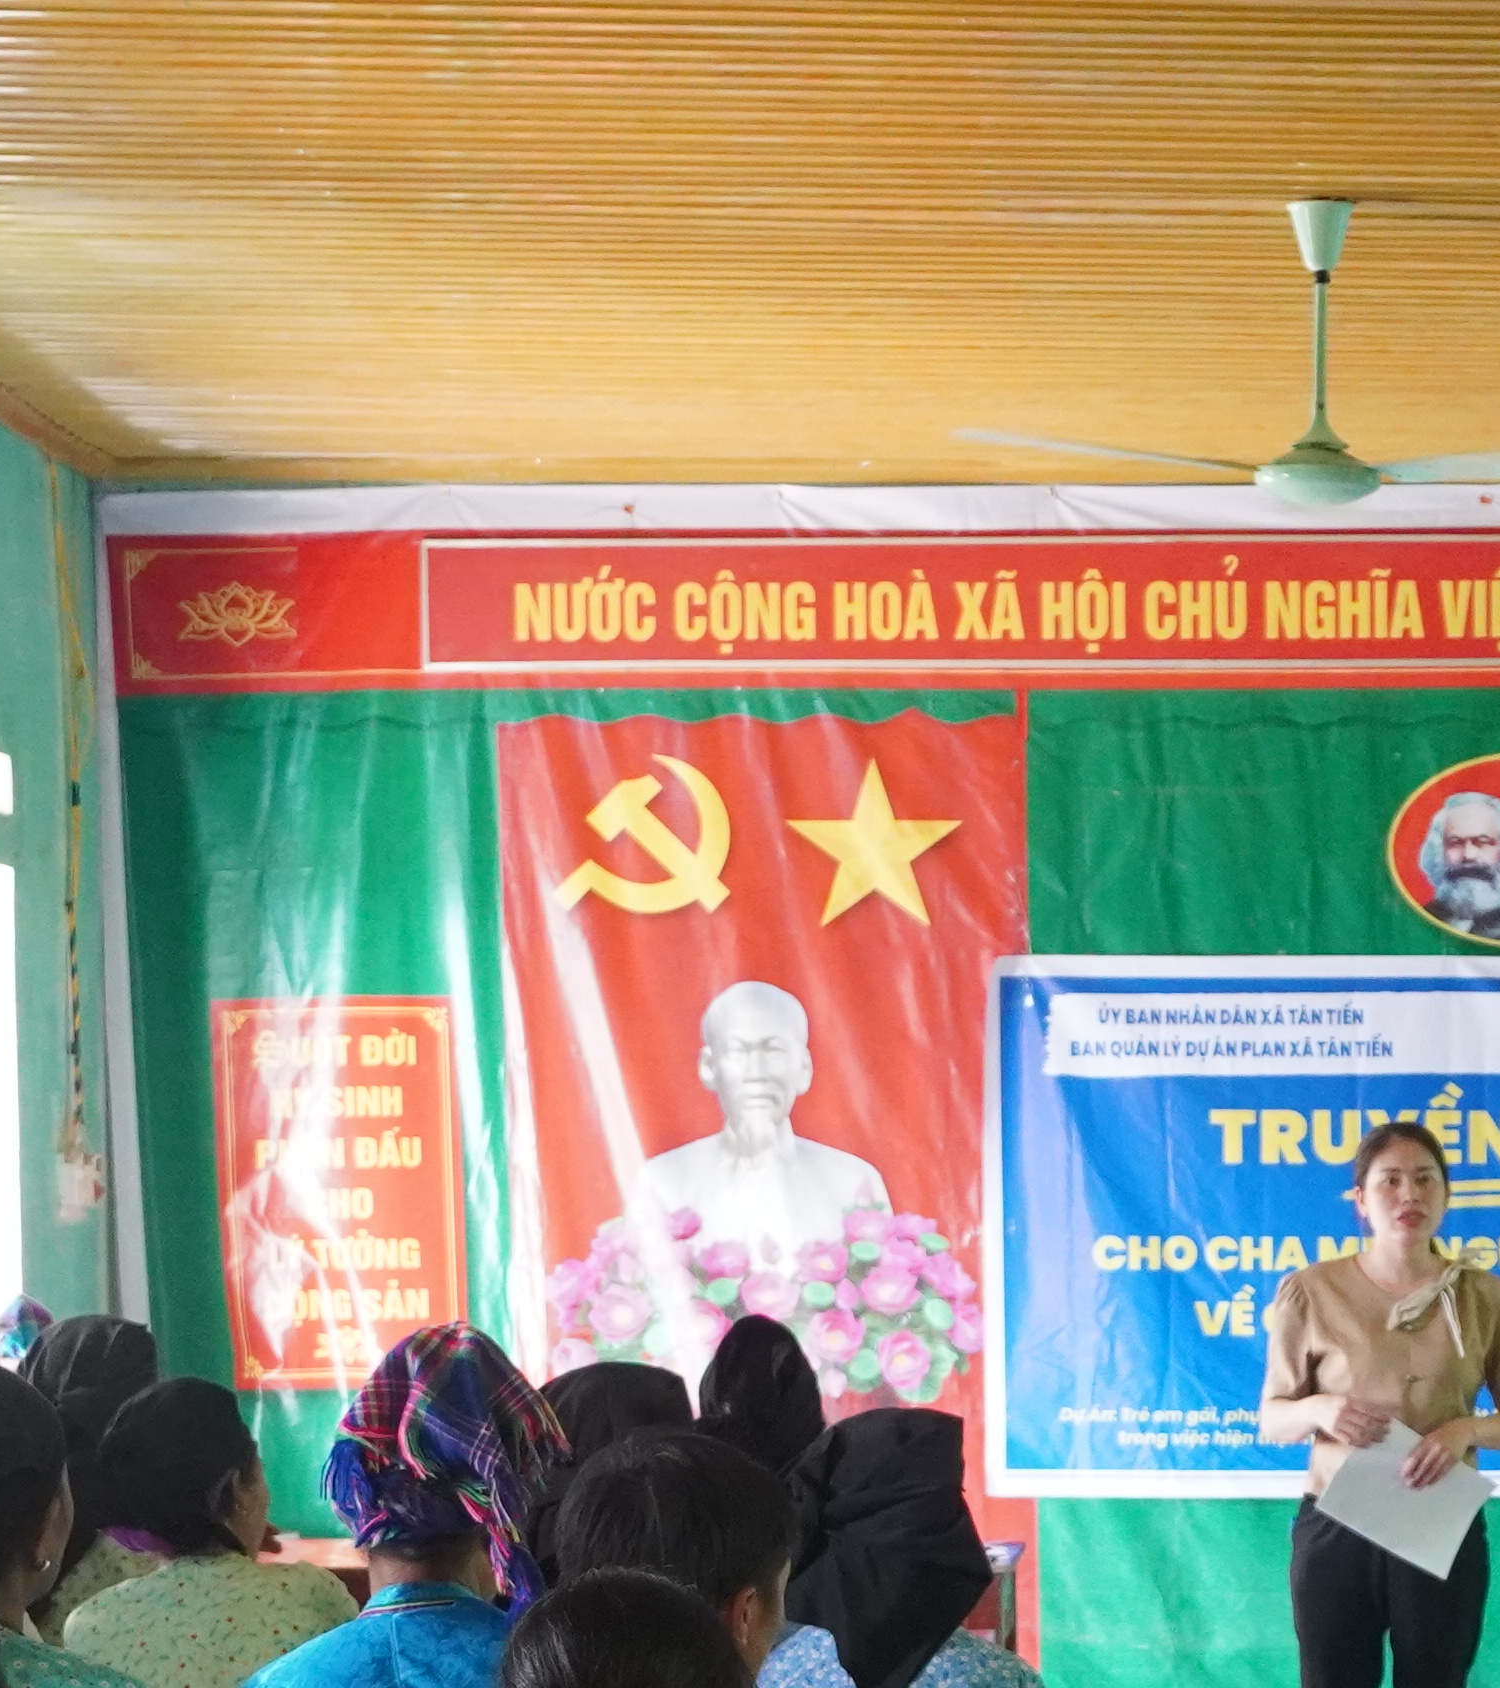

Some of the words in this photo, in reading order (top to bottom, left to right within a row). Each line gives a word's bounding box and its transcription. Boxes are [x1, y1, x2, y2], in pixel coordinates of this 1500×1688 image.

[514, 565, 657, 642] NƯỚC
[675, 570, 817, 654] CỘNG
[834, 569, 939, 641] HOÀ
[954, 570, 1025, 641] XÃ
[1041, 569, 1126, 654] HỘI
[1145, 555, 1247, 639] CHỦ
[1266, 568, 1425, 639] NGHĨA
[1126, 1009, 1162, 1025] BAN
[1166, 1005, 1216, 1025] NHÂN
[1221, 1004, 1257, 1025] DÂN
[1289, 1004, 1322, 1025] TÂN
[1326, 1001, 1363, 1025] TIẾN
[360, 1027, 417, 1067] ĐỜI
[1071, 1040, 1106, 1057] BAN
[1111, 1034, 1159, 1058] QUẢN
[1241, 1040, 1285, 1057] PLAN
[1317, 1036, 1351, 1057] TÂN
[1354, 1033, 1393, 1057] TIẾN
[326, 1085, 403, 1118] SINH
[354, 1127, 422, 1168] ĐẤU
[1092, 1235, 1198, 1271] CHO
[1205, 1235, 1310, 1271] CHA
[361, 1278, 430, 1320] SẢN
[1193, 1284, 1256, 1337] VỀ
[1152, 1408, 1183, 1422] em
[1118, 1430, 1169, 1449] trong
